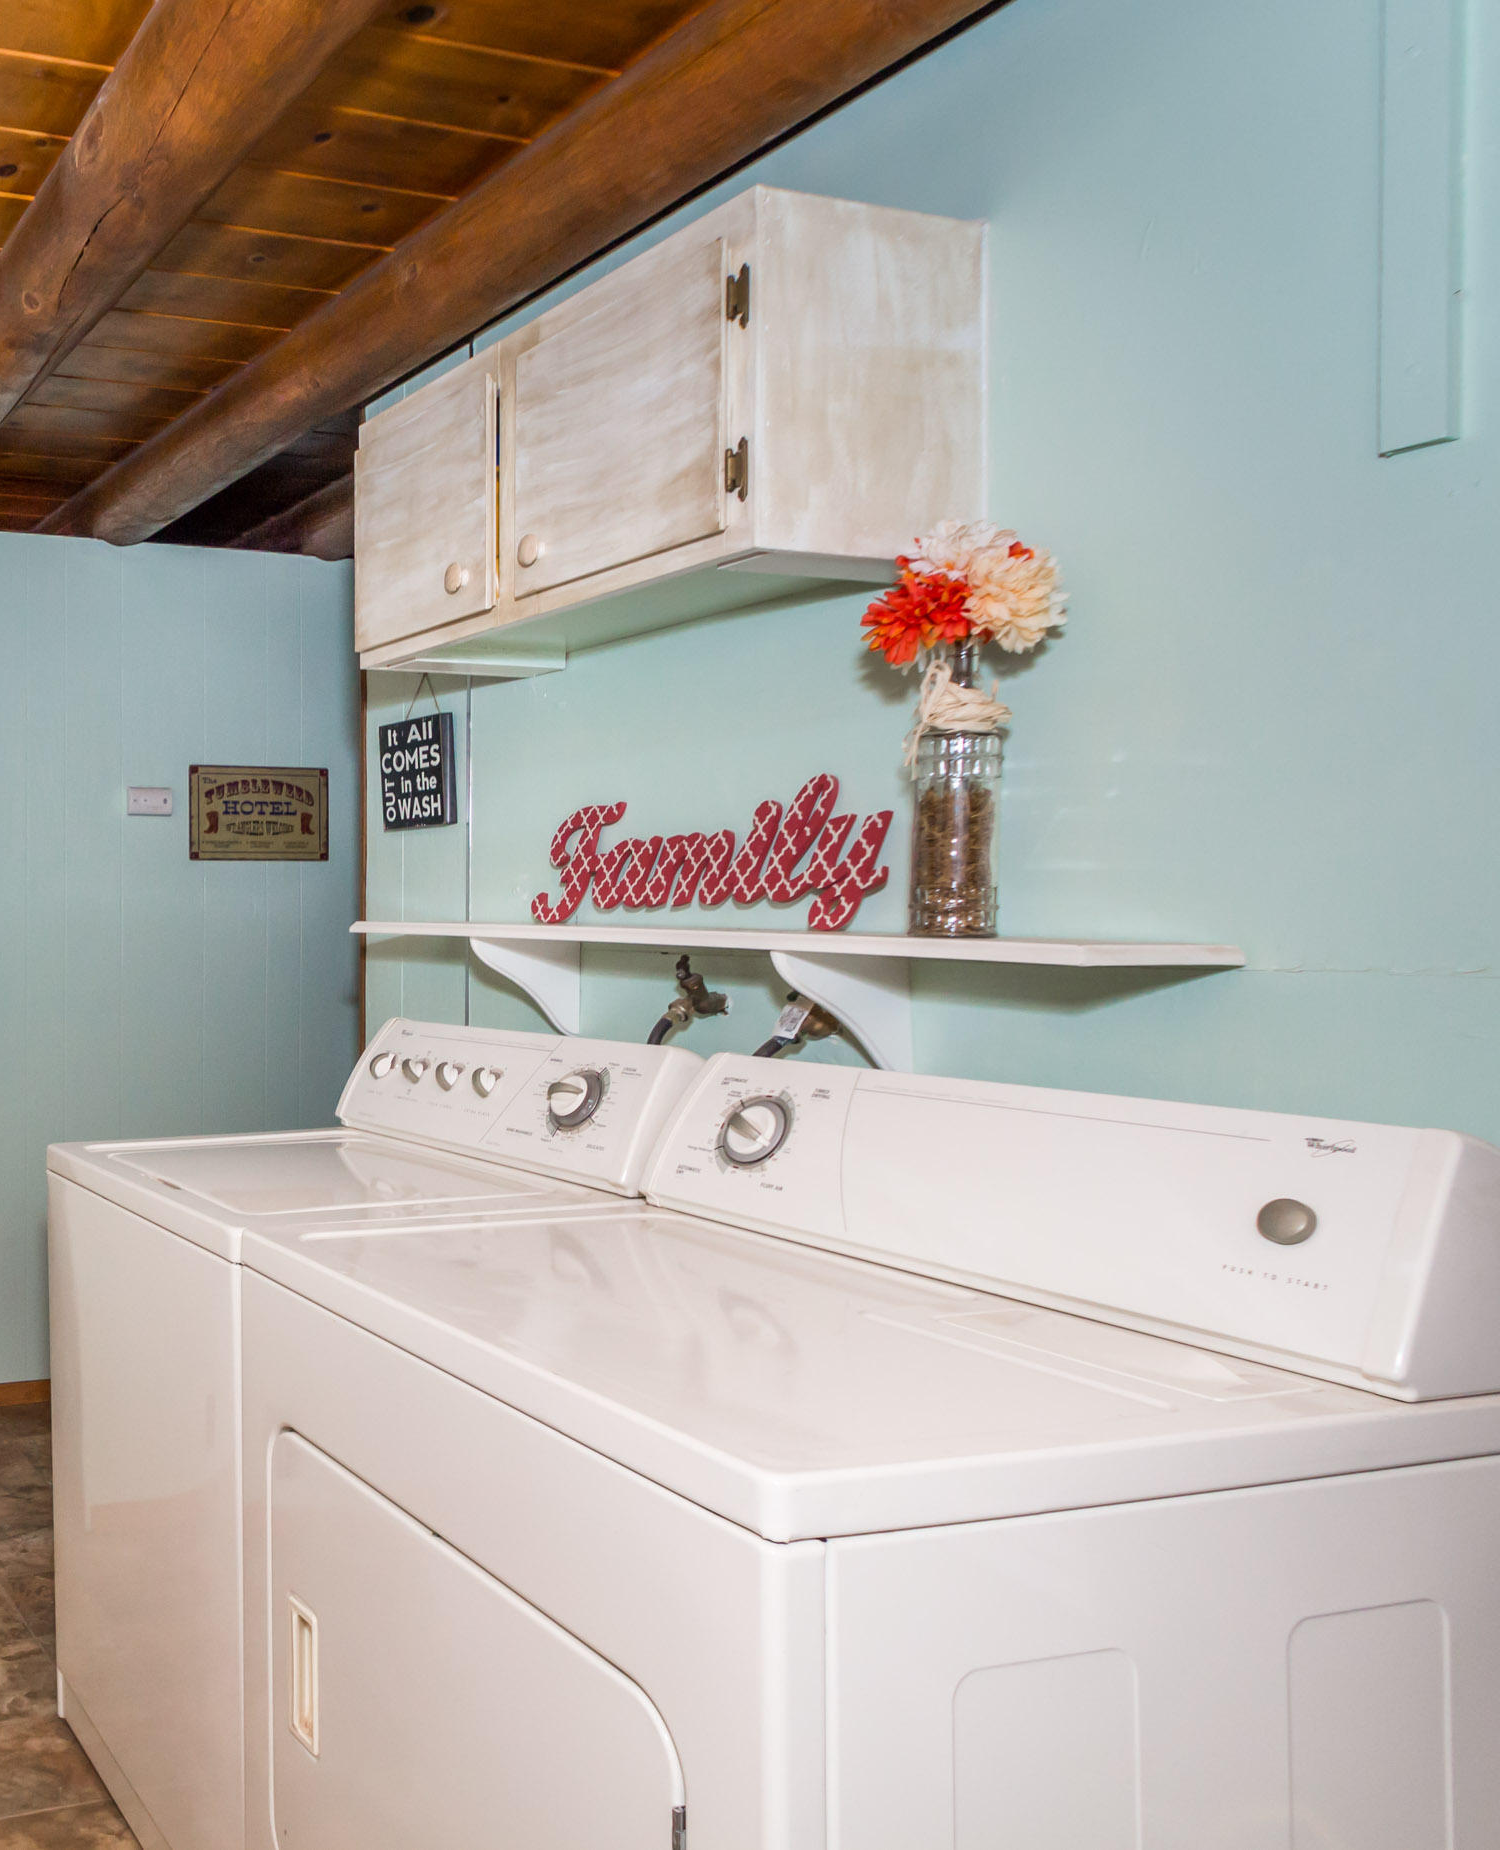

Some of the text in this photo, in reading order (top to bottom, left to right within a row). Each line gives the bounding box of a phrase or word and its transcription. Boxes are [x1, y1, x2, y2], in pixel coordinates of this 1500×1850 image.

[387, 720, 433, 747] It All
[381, 744, 440, 774] COMES
[204, 778, 315, 807] TUMBLEWEED
[400, 771, 437, 794] in the
[222, 800, 297, 816] HOTEL
[384, 778, 396, 822] OUT
[397, 794, 442, 820] WASH
[531, 773, 894, 931] Family
